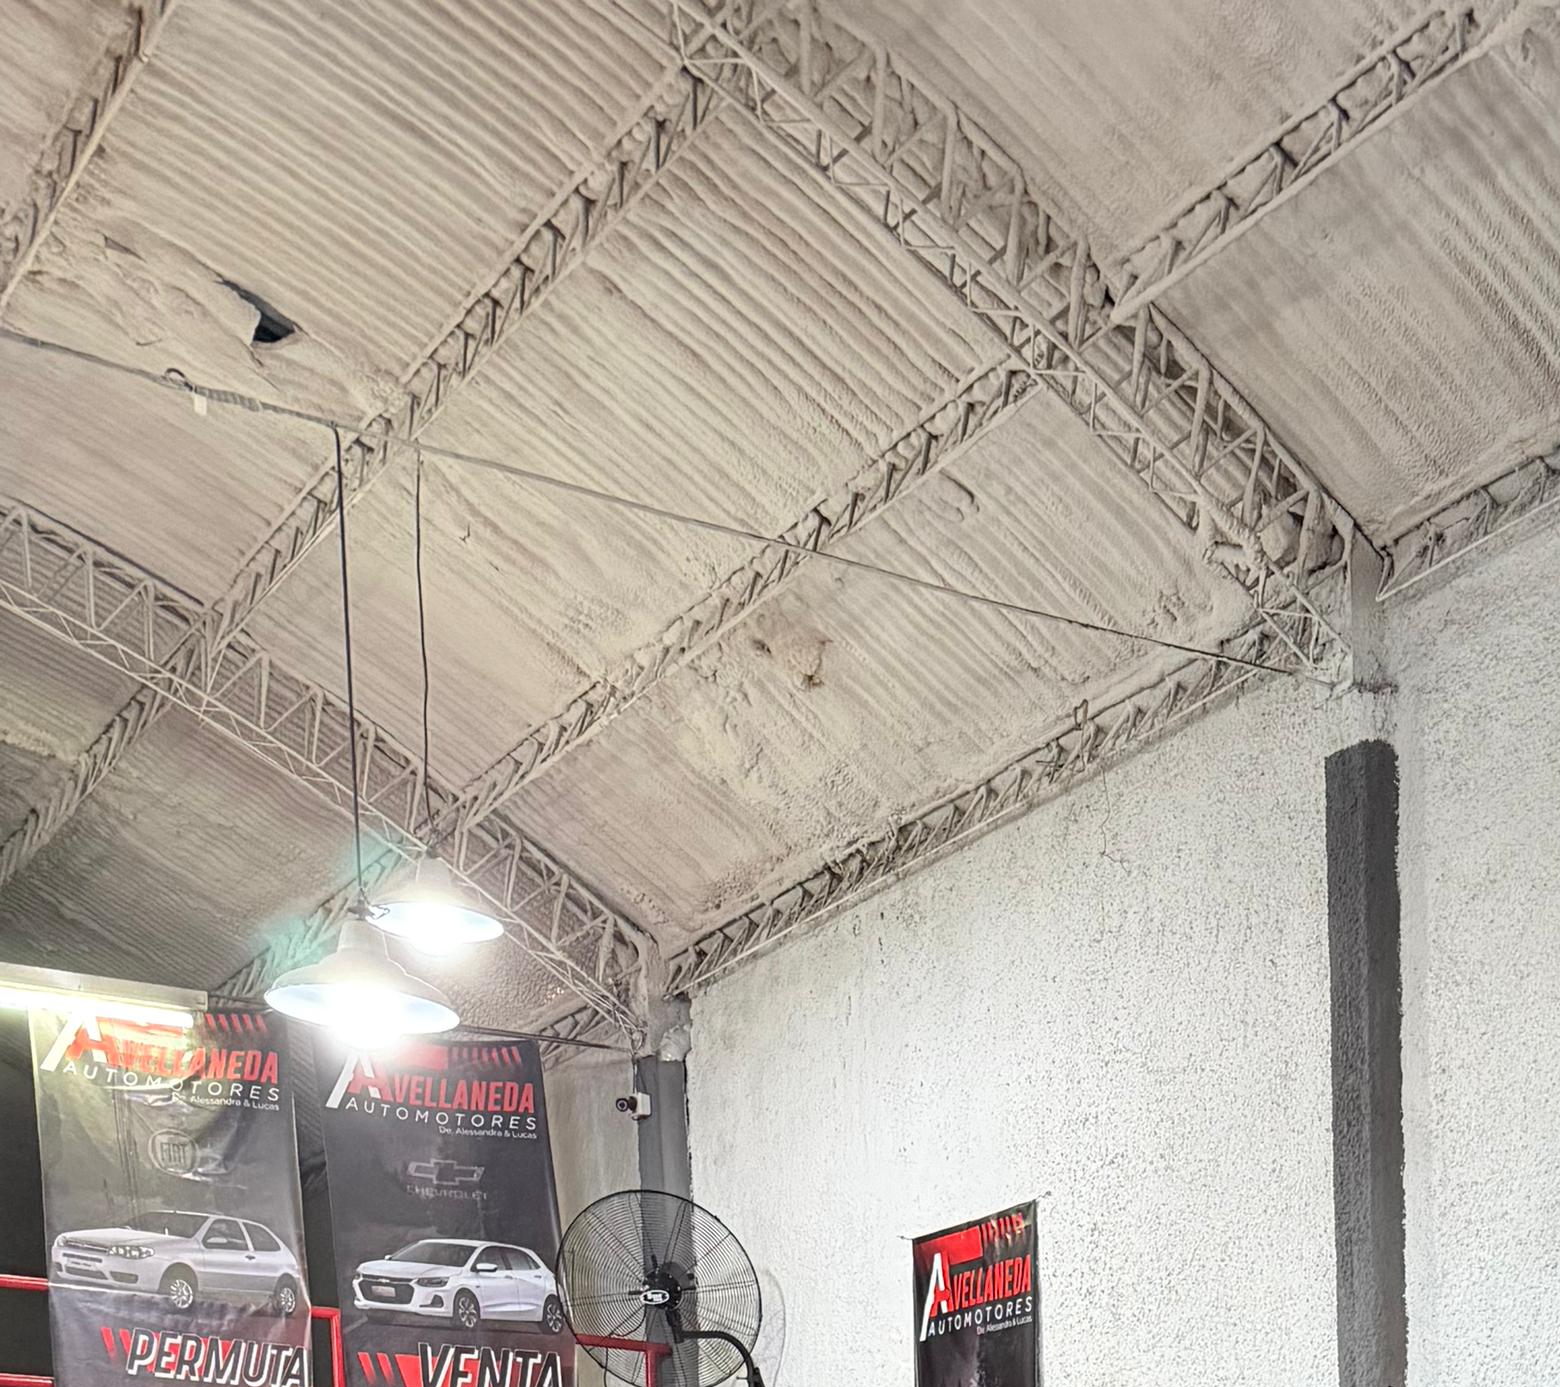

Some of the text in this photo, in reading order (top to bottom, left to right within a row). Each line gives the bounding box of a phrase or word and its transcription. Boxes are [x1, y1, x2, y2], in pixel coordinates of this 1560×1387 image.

[40, 1008, 279, 1085] AVELLANEDA
[63, 1062, 280, 1101] AUTOMOTORES
[325, 1048, 535, 1114] AVELLANEDA
[190, 1095, 242, 1106] Alessandra
[252, 1101, 280, 1111] Lucas
[345, 1097, 537, 1130] AUTOMOTORES
[161, 1143, 188, 1164] FIAT
[455, 1128, 503, 1137] Alessandra
[512, 1130, 538, 1140] Lucas
[919, 1250, 1032, 1341] AVELLANEDA
[928, 1296, 1033, 1336] AUTOMOTORES
